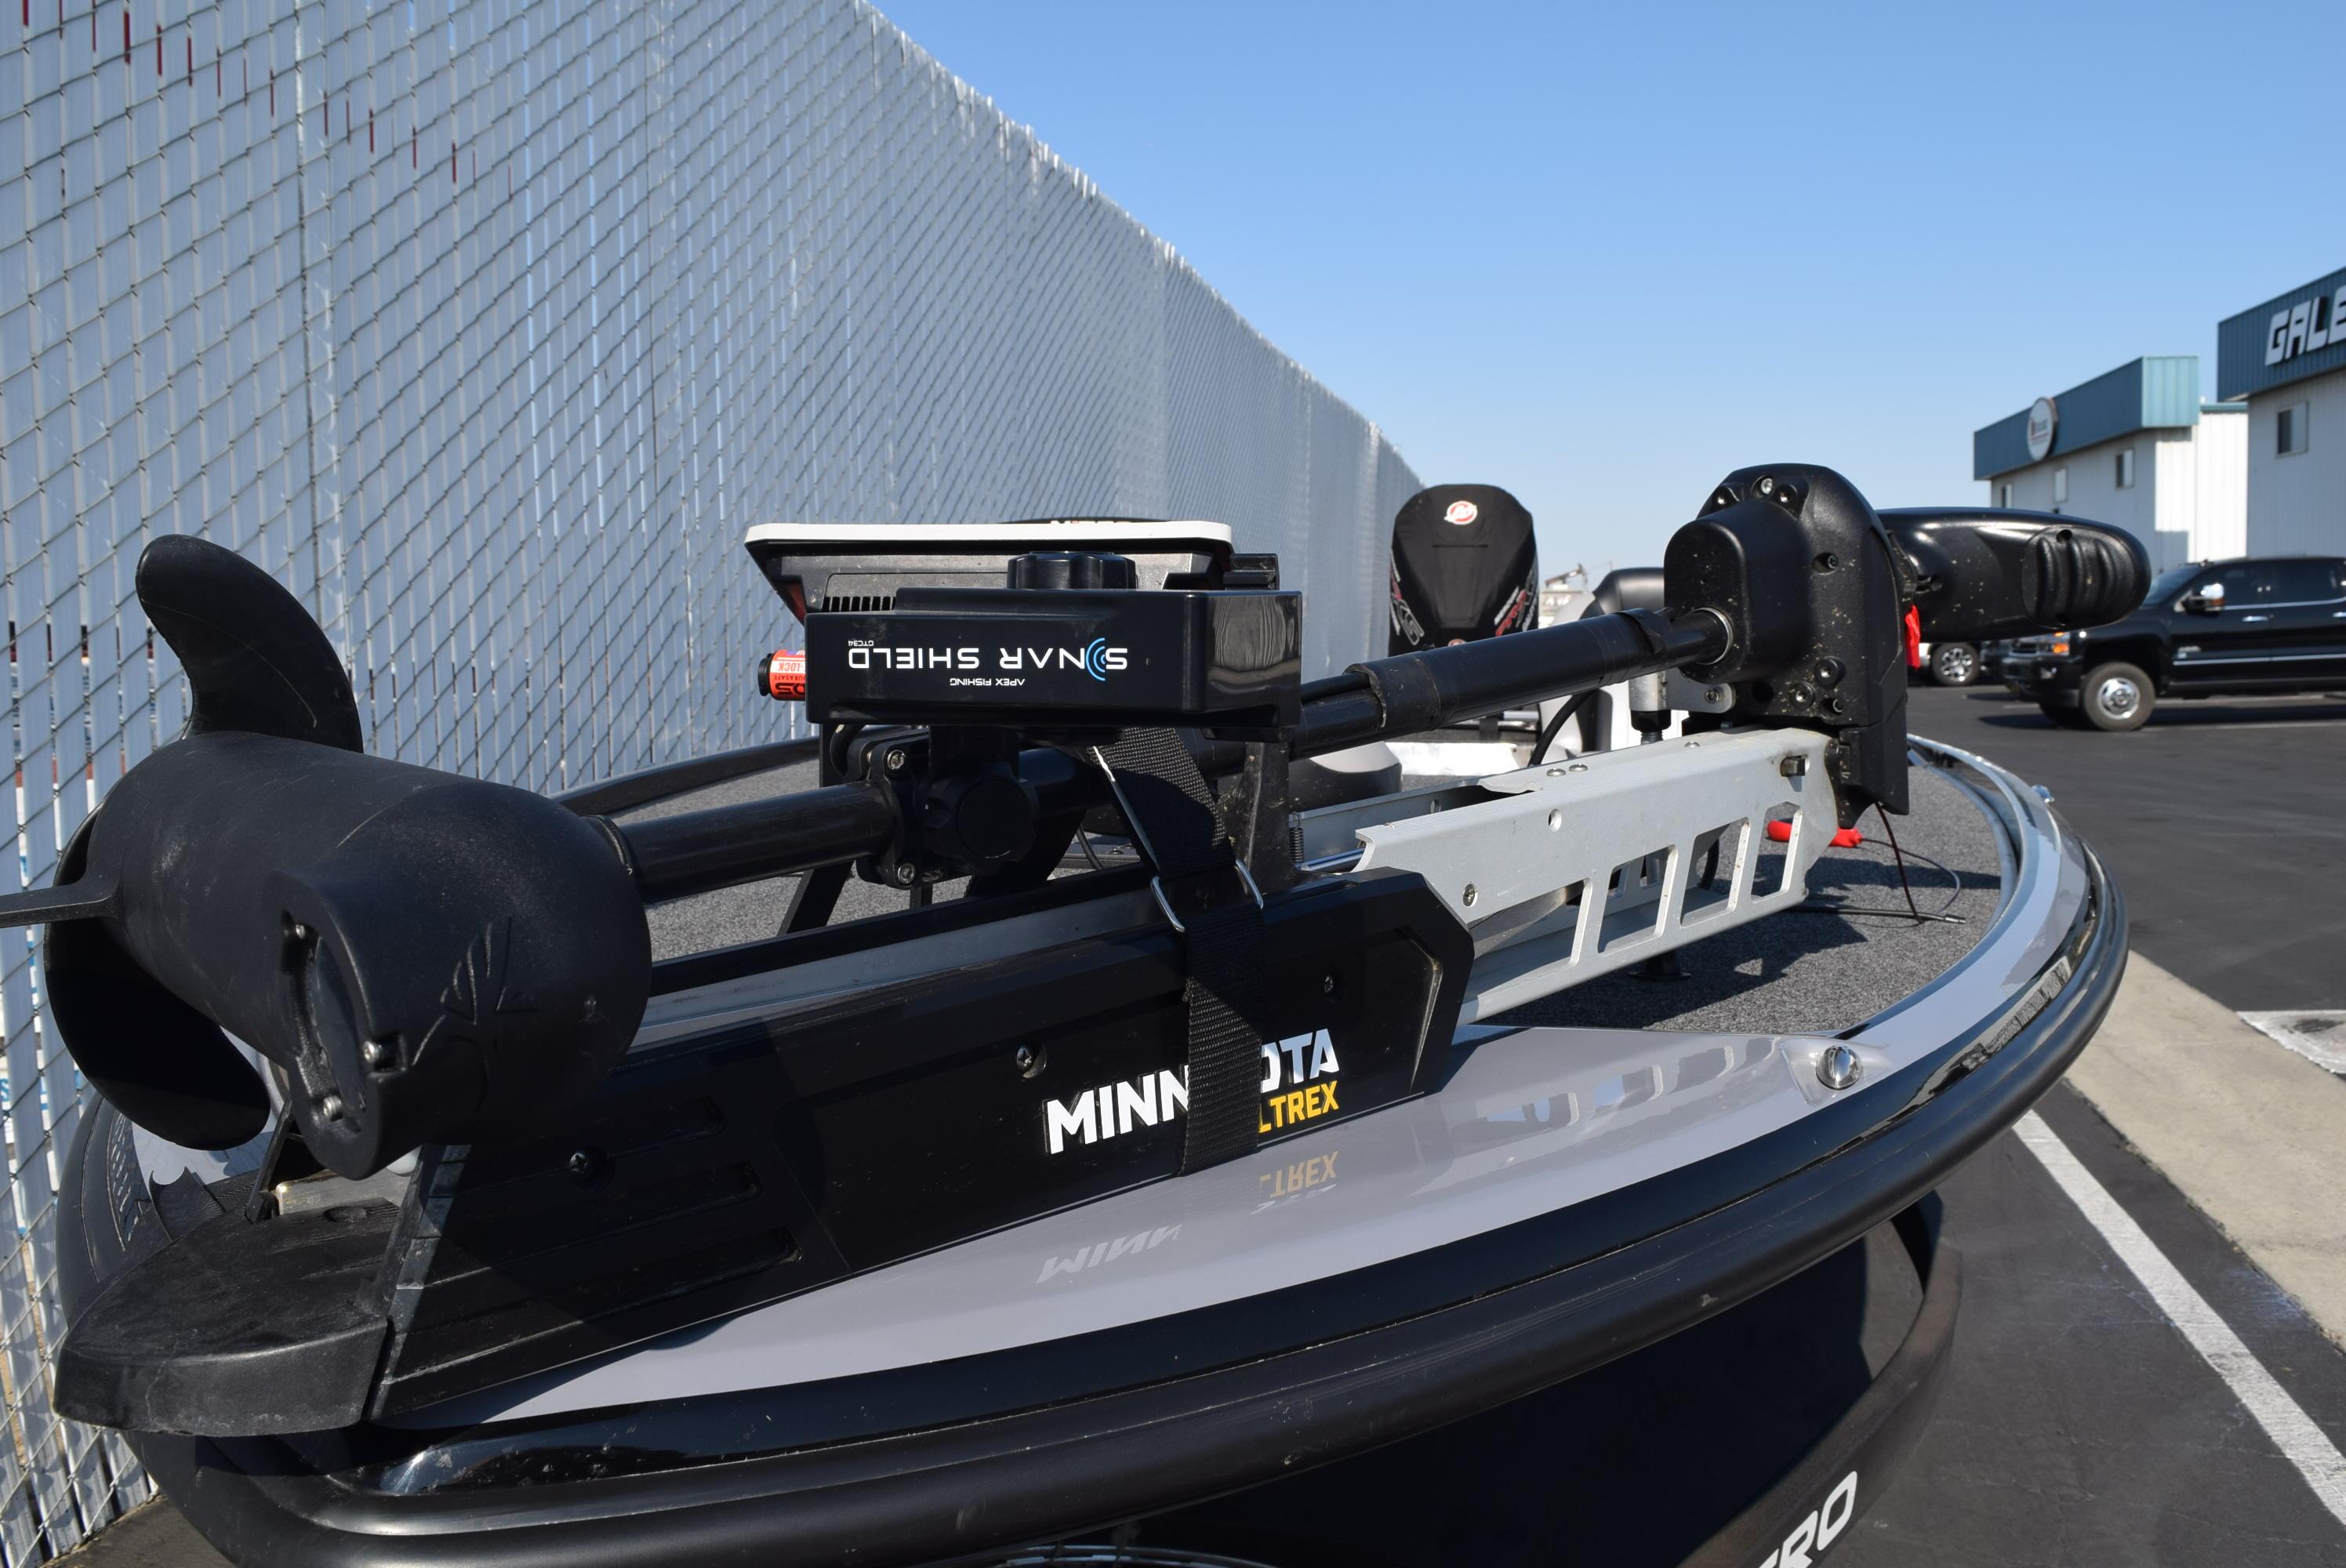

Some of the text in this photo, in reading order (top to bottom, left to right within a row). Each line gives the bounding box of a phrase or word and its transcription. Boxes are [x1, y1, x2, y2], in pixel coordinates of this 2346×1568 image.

[778, 662, 805, 672] -LOCK
[848, 648, 980, 669] SHIELD
[1046, 1028, 1339, 1154] MINNOTA
[1258, 1080, 1339, 1134] LTREX
